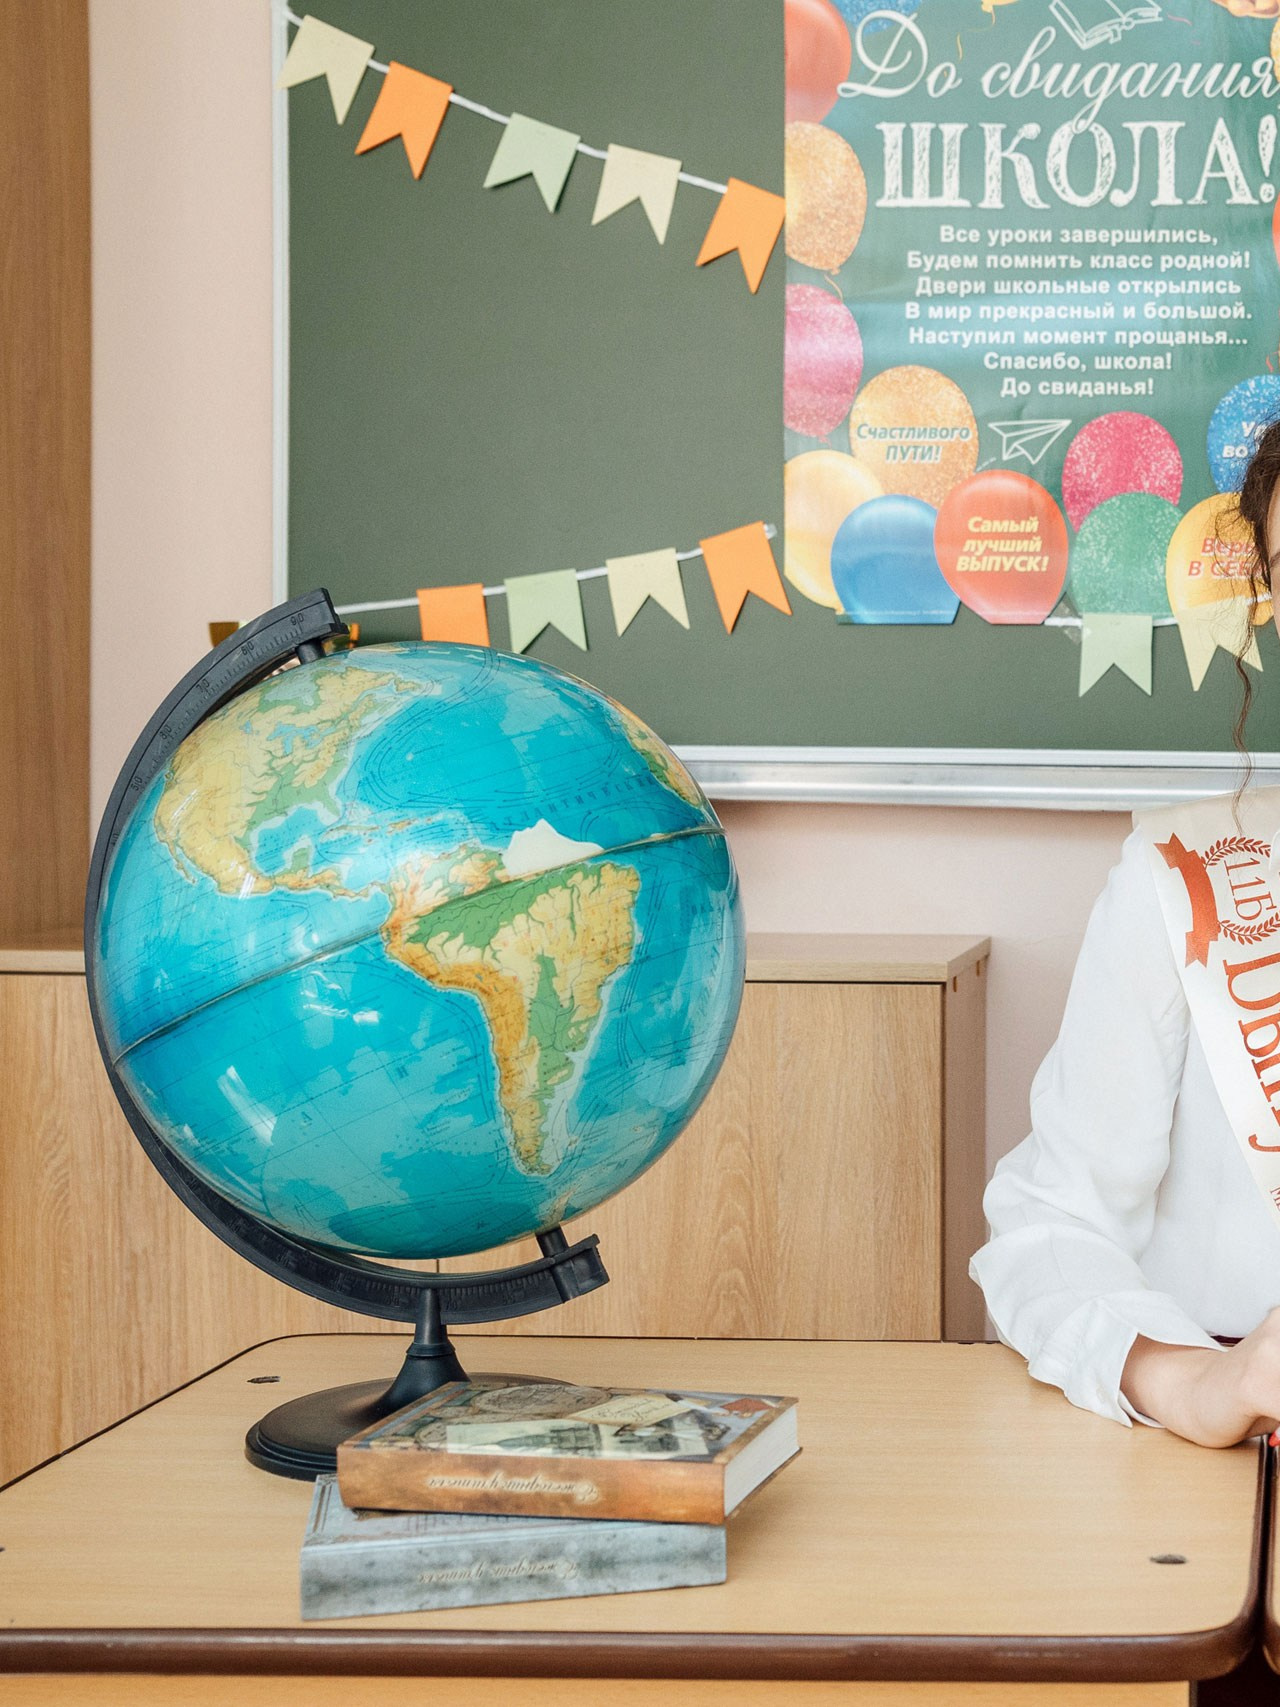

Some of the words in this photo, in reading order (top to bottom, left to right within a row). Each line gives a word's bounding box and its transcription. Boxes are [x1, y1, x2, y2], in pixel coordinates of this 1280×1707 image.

[837, 9, 962, 98] До
[875, 114, 1278, 209] ШКОЛА!
[940, 225, 980, 244] Все
[988, 228, 1052, 246] уроки
[1060, 228, 1218, 246] завершились,
[907, 250, 978, 272] Будем
[986, 254, 1083, 270] помнить
[1090, 254, 1153, 270] класс
[1161, 250, 1250, 272] родной!
[915, 275, 986, 297] Двери
[994, 279, 1110, 295] школьные
[1118, 279, 1241, 297] открылись
[905, 302, 920, 320] В
[928, 305, 972, 323] мир
[980, 301, 1115, 323] прекрасный
[1123, 305, 1136, 320] и
[1144, 301, 1252, 320] большой.
[909, 326, 1015, 348] Наступил
[1023, 330, 1108, 346] момент
[1115, 330, 1248, 349] прощанья...
[984, 351, 1086, 372] Спасибо,
[1094, 352, 1172, 370] школа!
[1000, 377, 1031, 398] До
[1038, 377, 1154, 398] свиданья!
[857, 423, 971, 441] Счастливого
[885, 445, 943, 464] ПУТИ!
[968, 516, 1039, 533] Самый
[963, 536, 1042, 556] лучший
[956, 556, 1049, 572] ВЫПУСК!
[1224, 857, 1278, 922] 11Б
